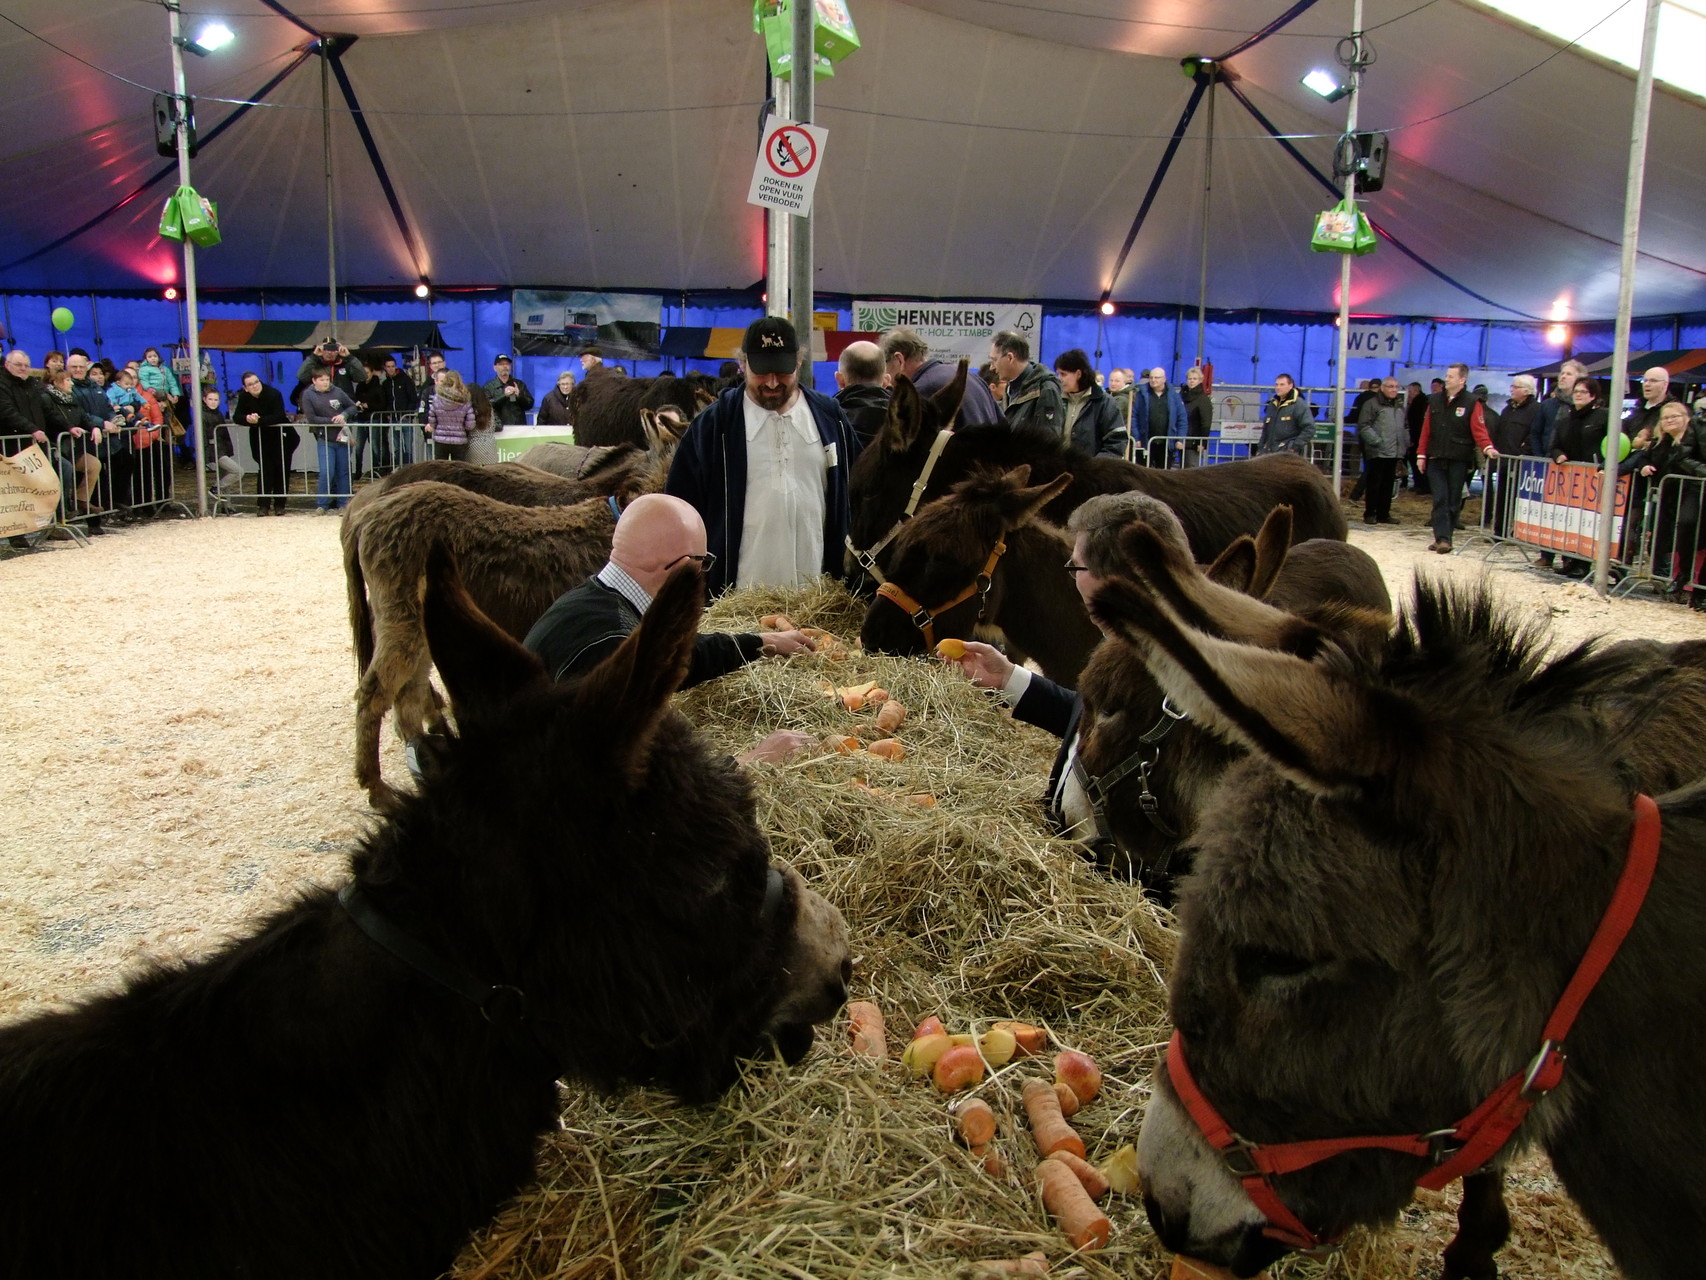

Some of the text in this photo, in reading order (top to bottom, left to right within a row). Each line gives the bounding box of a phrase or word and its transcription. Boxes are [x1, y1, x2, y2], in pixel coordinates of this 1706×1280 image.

[759, 184, 804, 201] OPEN VUUR
[763, 176, 803, 192] ROKEN EN
[758, 193, 801, 209] VERBODEN
[897, 309, 995, 326] HENNEKENS
[1347, 332, 1379, 351] WC
[1520, 470, 1544, 494] John
